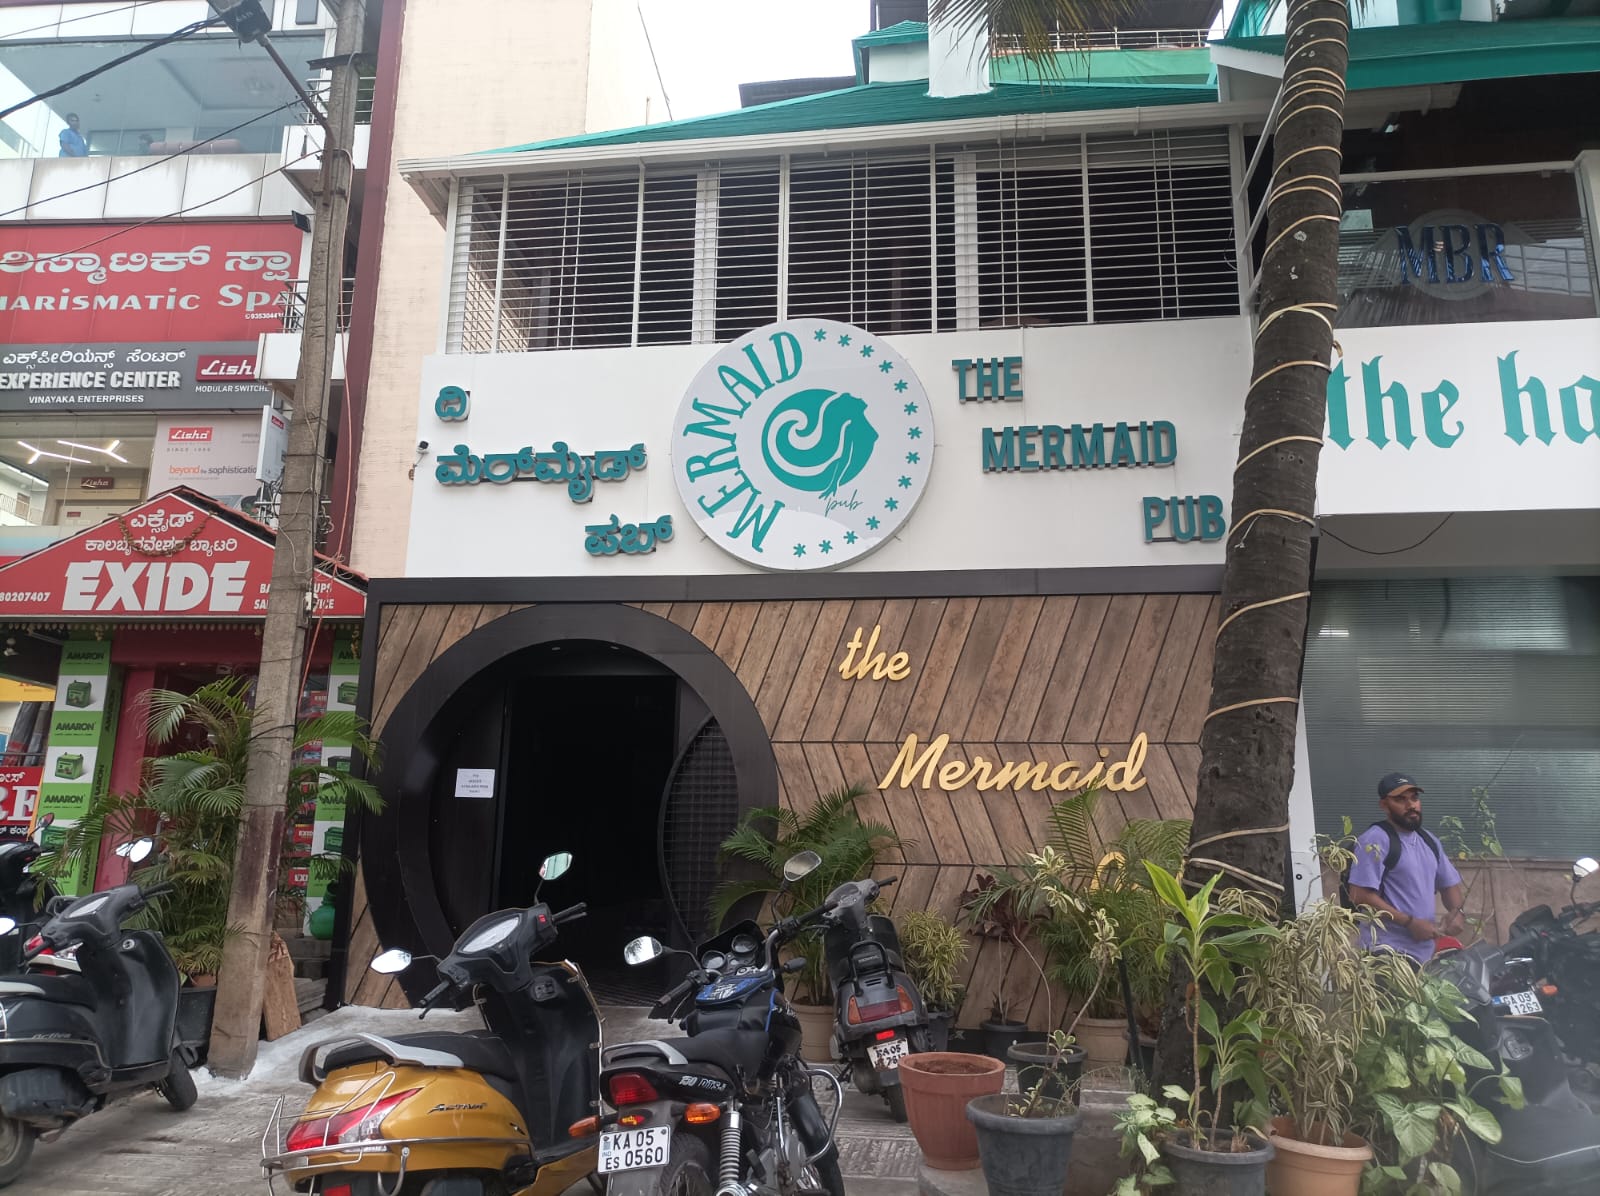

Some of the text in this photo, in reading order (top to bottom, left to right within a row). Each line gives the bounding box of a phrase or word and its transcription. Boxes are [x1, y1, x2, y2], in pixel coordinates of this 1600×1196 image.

[1395, 223, 1514, 283] MBR
[0, 370, 181, 390] EXPERIENCE CENTER
[201, 359, 257, 376] Lish
[952, 356, 1023, 403] THE
[29, 394, 144, 404] VINAYAKA ENTERPRISES
[195, 385, 233, 393] MODULAR
[435, 386, 469, 420] ದಿ
[1327, 355, 1464, 451] the
[683, 331, 803, 553] MERMAID
[982, 420, 1177, 473] MERMAID
[169, 465, 200, 476] beyond
[819, 489, 863, 517] pub
[1142, 495, 1226, 543] PUB
[584, 513, 674, 556] ಪಬ್
[62, 560, 251, 611] EXIDE
[838, 625, 911, 681] the
[55, 722, 95, 731] AMARON
[877, 732, 1148, 791] Mermaid
[44, 794, 84, 803] AMARON
[613, 1129, 655, 1151] KA 05
[605, 1146, 664, 1170] ES 0560
